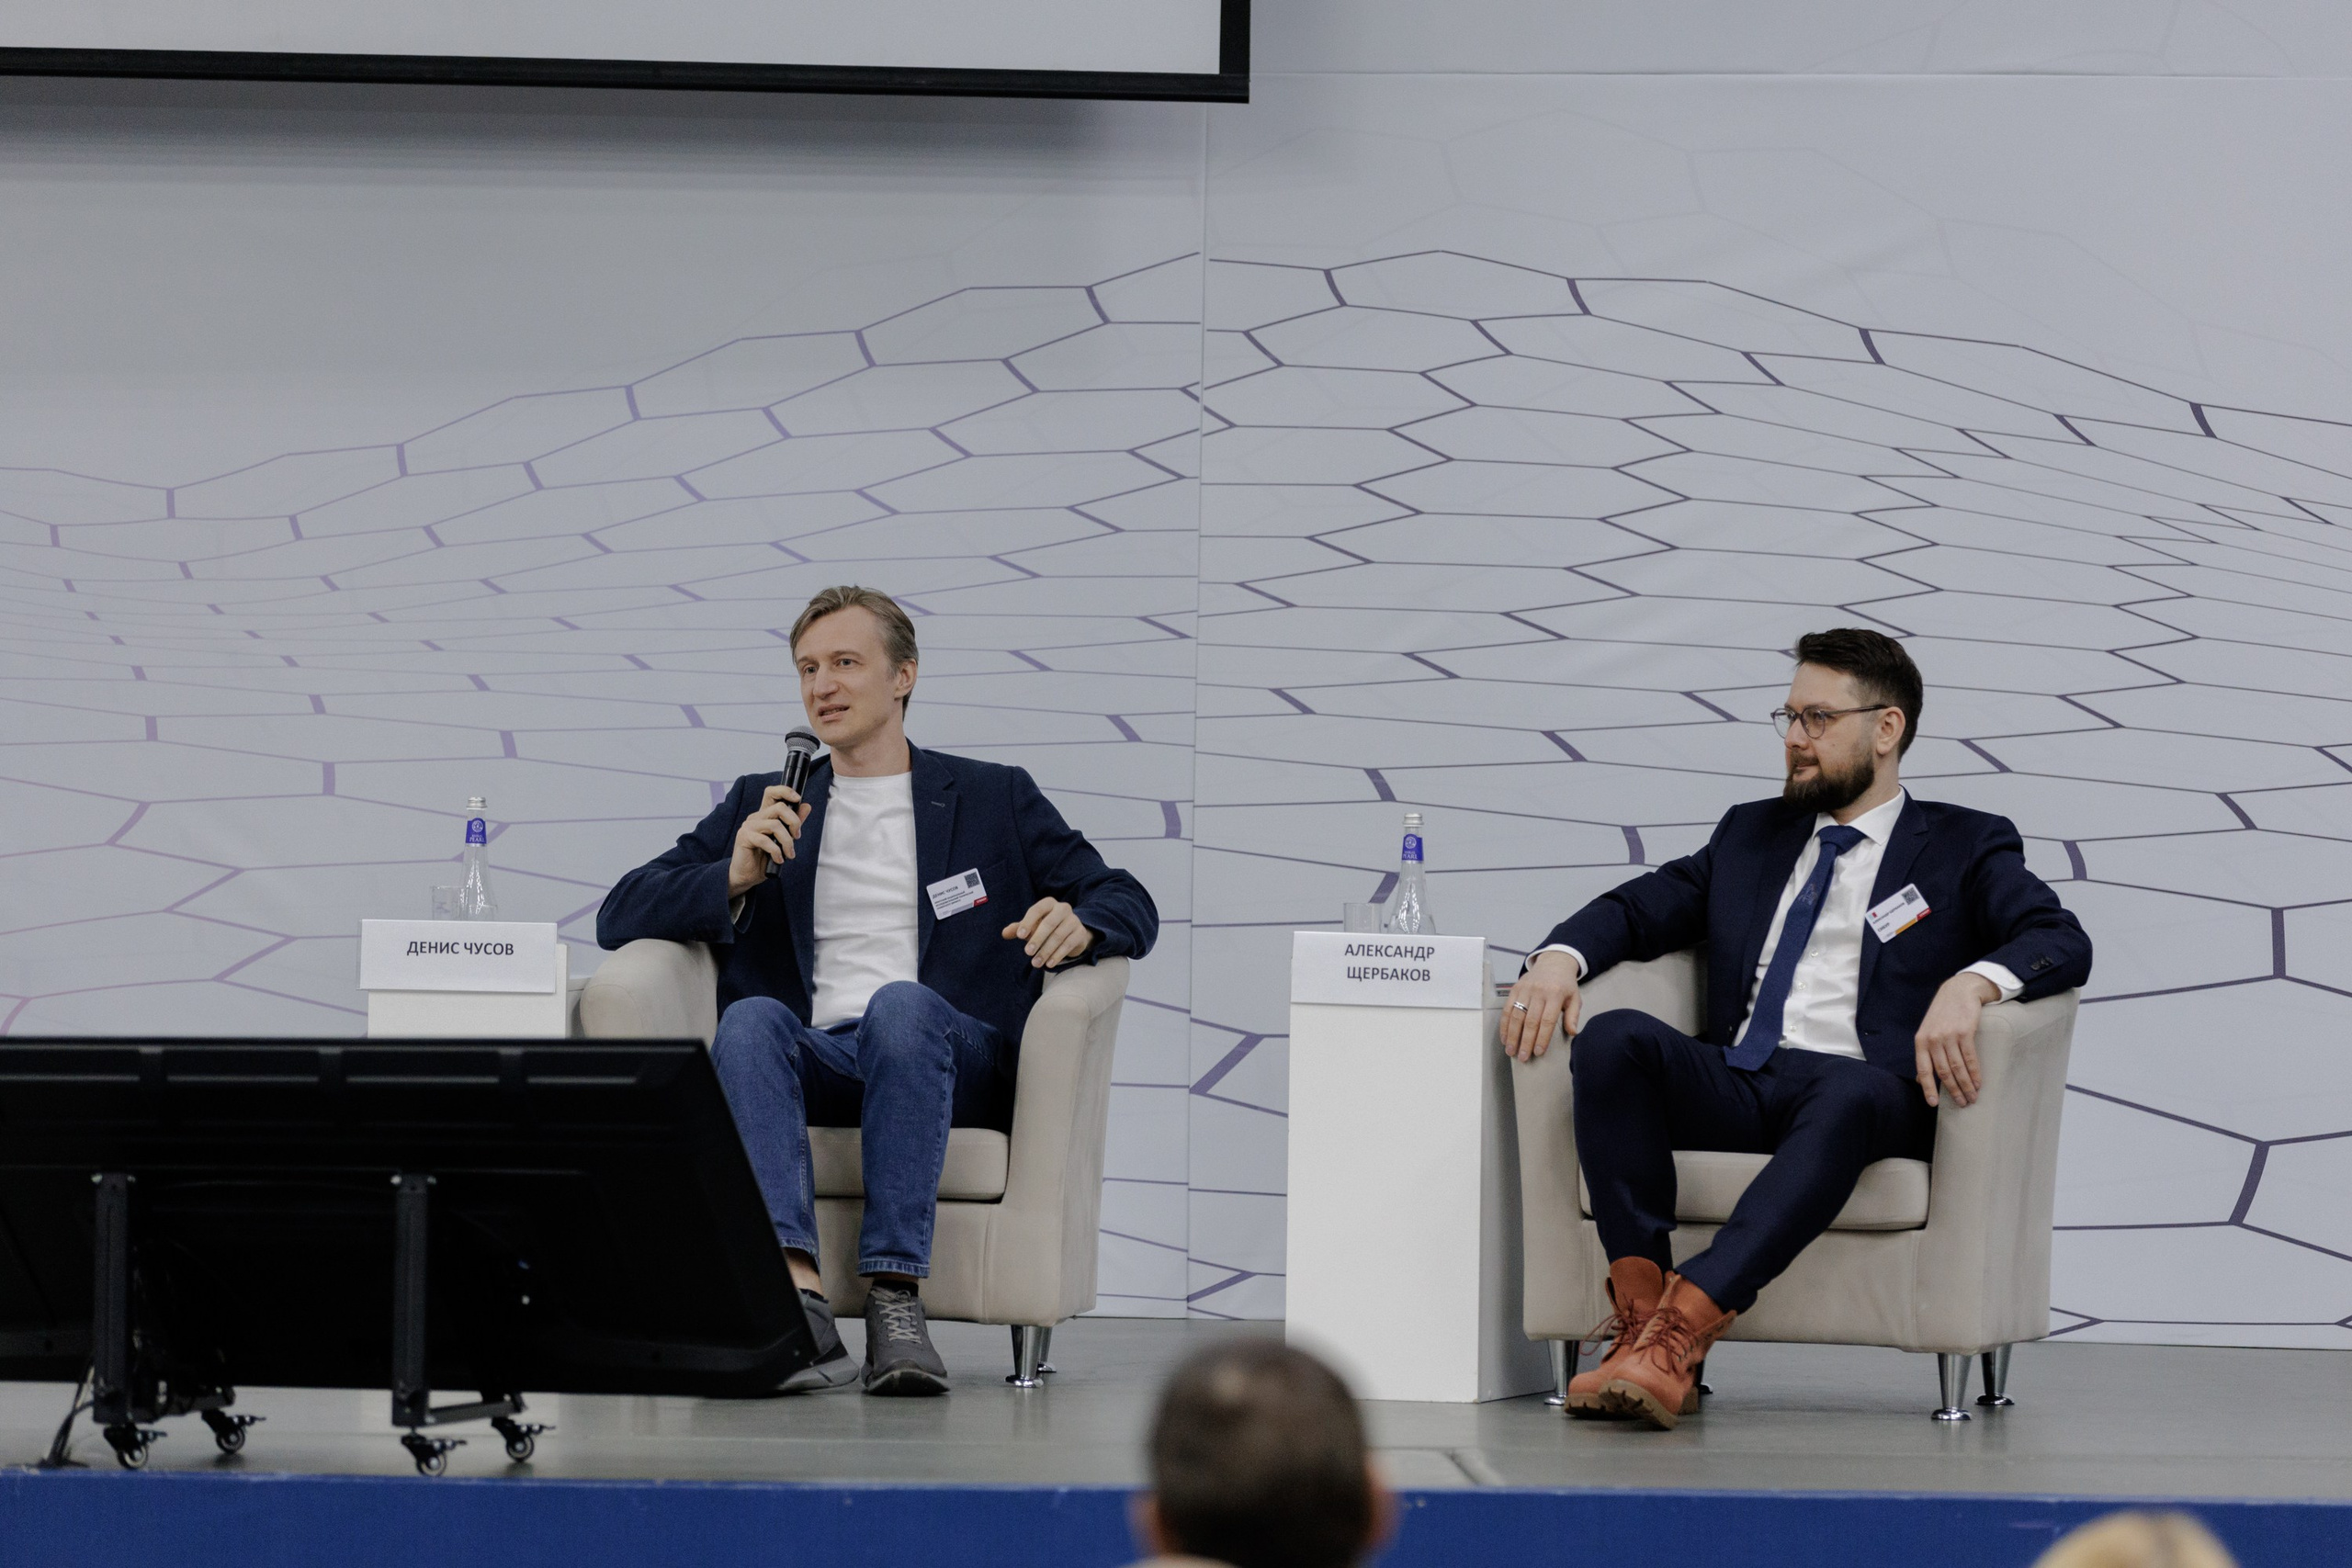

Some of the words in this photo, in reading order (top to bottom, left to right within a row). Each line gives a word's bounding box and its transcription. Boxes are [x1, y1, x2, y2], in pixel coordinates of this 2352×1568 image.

[406, 941, 459, 956] ДЕНИС
[463, 942, 514, 956] ЧУСОВ
[1344, 943, 1435, 962] АЛЕКСАНДР
[1347, 966, 1430, 982] ЩЕРБАКОВ
